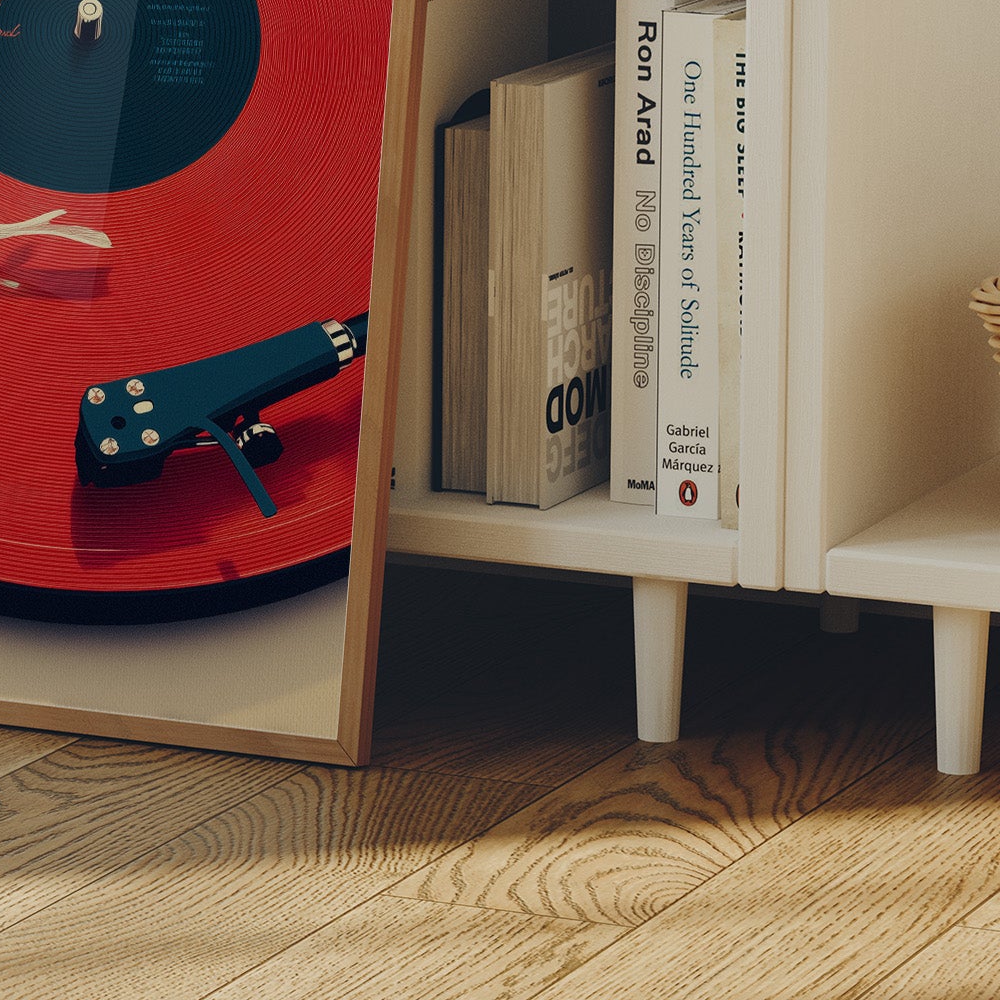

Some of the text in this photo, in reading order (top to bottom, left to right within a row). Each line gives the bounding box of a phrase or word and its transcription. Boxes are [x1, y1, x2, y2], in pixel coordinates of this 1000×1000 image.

[630, 20, 658, 389] Ron Arad No Discipline
[680, 60, 702, 379] One Hundred Years of Solitude
[546, 365, 607, 434] MOD
[666, 424, 709, 438] Gabriel
[669, 441, 706, 455] García
[662, 458, 714, 473] Márquez
[627, 479, 655, 490] MoMA
